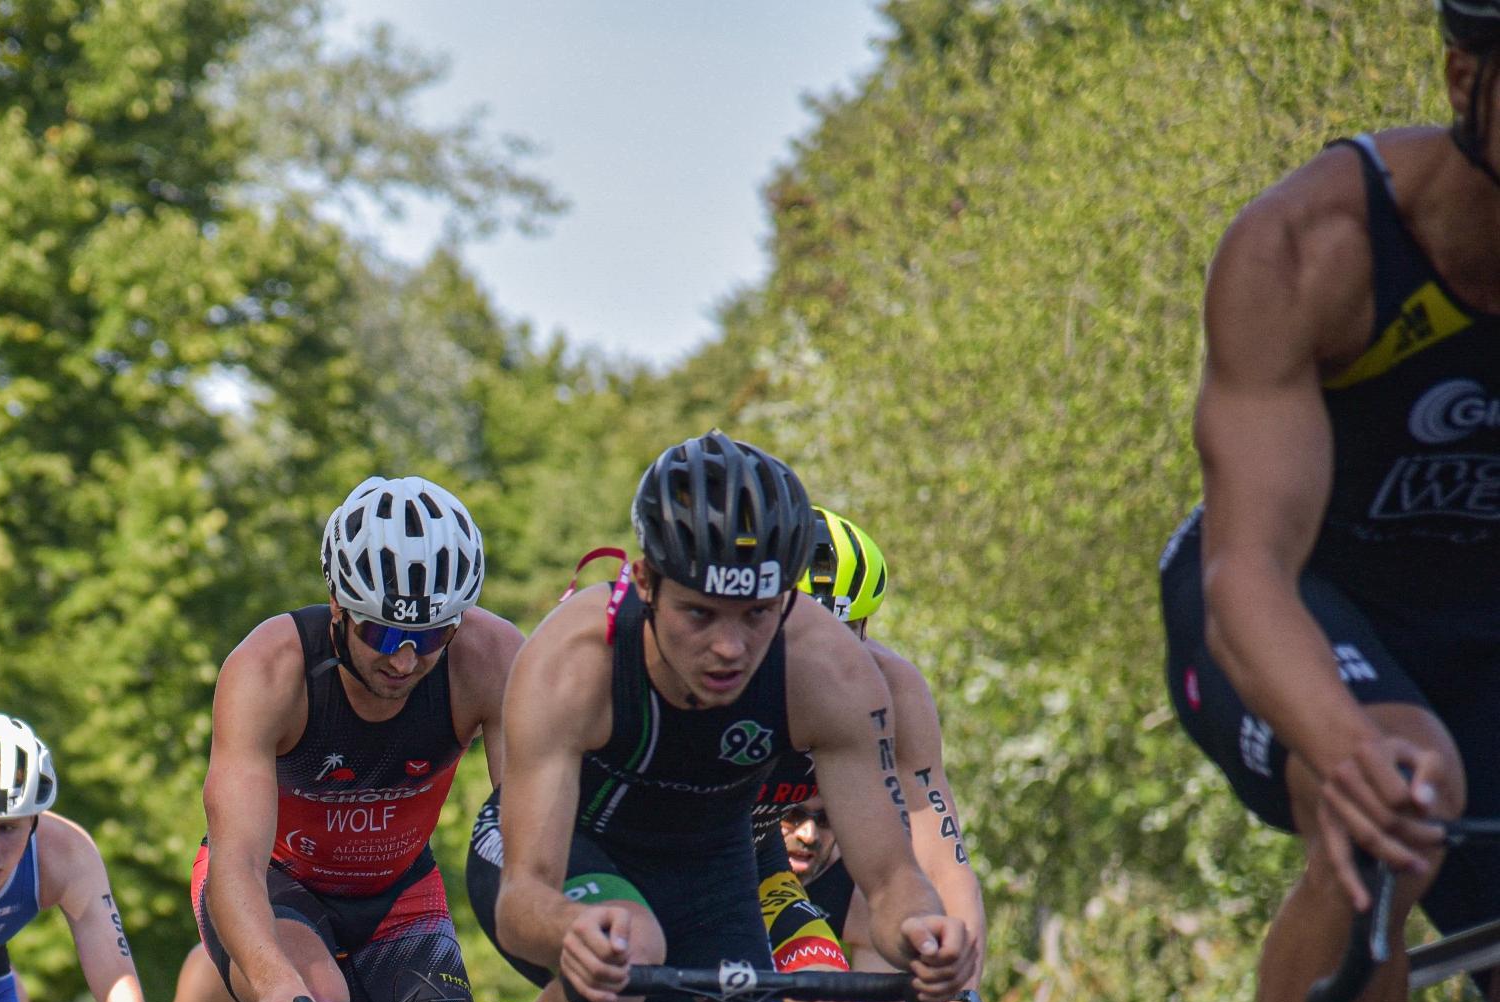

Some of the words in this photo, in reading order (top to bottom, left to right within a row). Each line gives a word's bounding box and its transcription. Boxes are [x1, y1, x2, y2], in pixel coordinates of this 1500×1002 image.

[704, 565, 756, 596] N29
[393, 599, 419, 622] 34
[718, 720, 774, 765] 96
[326, 805, 397, 833] WOLF
